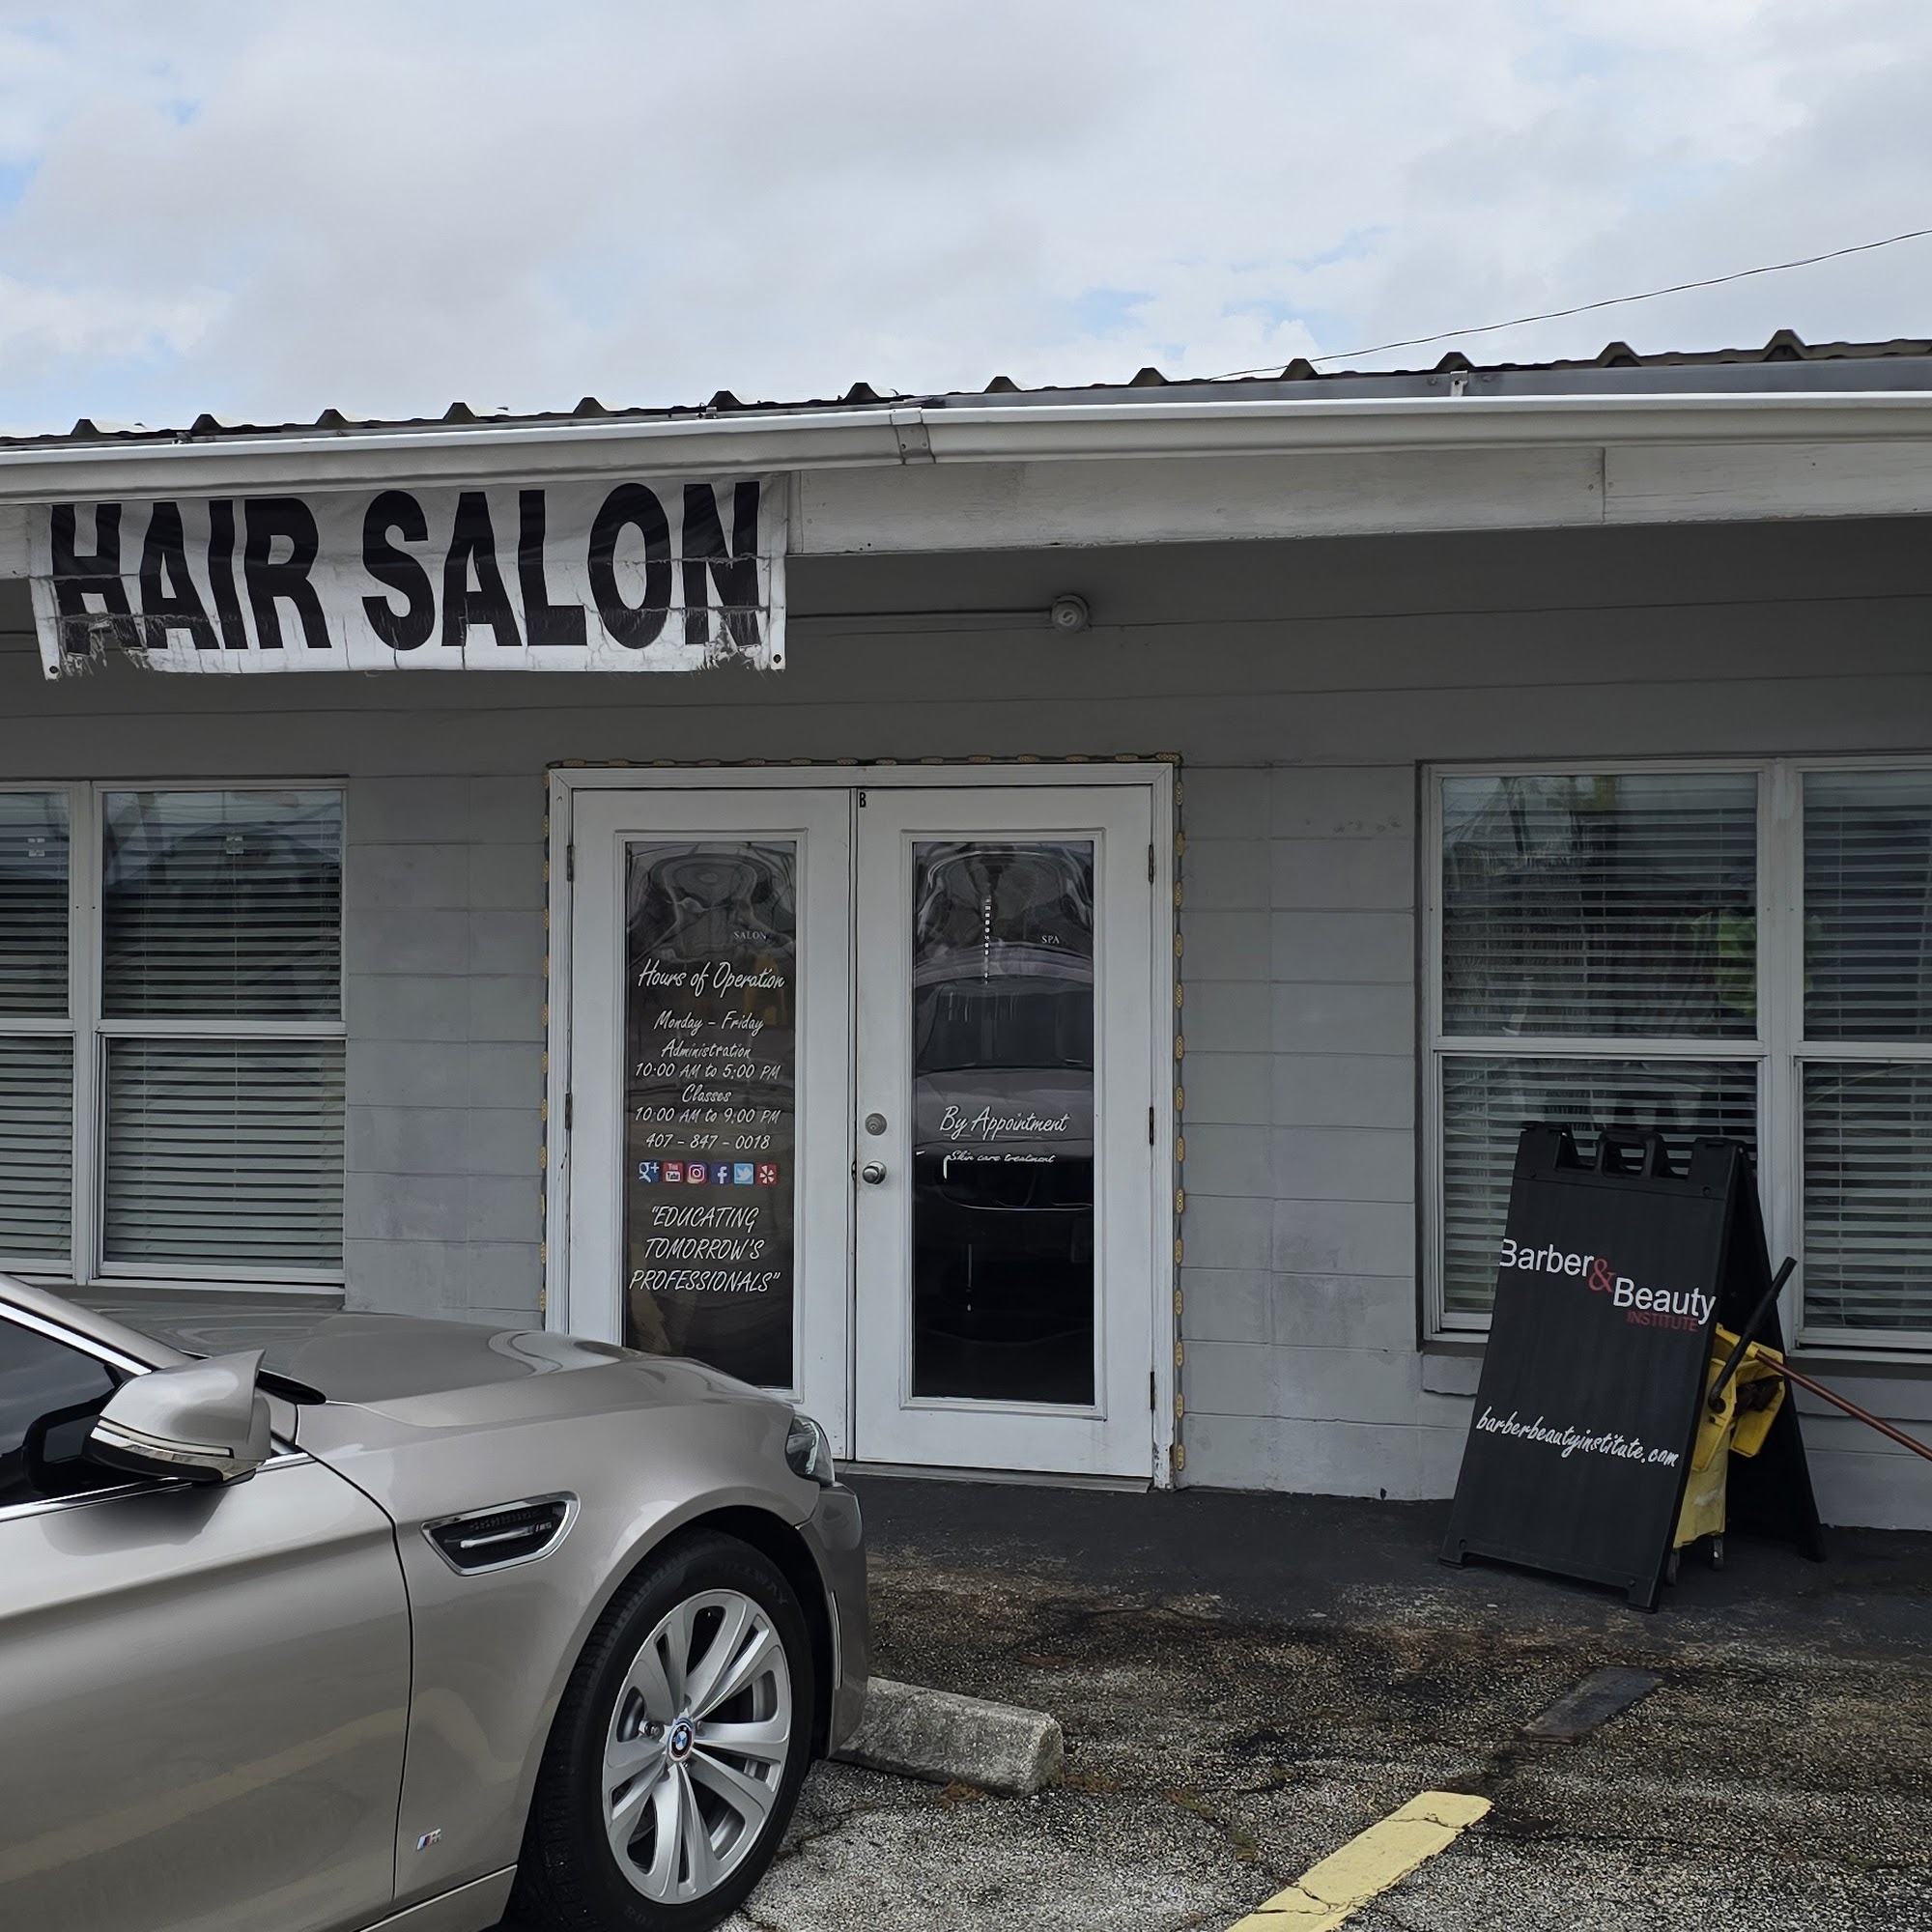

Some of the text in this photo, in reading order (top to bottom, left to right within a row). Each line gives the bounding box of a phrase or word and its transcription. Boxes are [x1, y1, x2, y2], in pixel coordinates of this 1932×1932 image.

[50, 481, 761, 655] HAIR SALON
[733, 930, 767, 940] SALON
[1041, 935, 1061, 945] SPA
[638, 958, 785, 998] Hours of Operation
[653, 1009, 703, 1036] Monday
[721, 1010, 764, 1037] Friday
[661, 1038, 751, 1058] Administration
[635, 1063, 781, 1080] 10:00 AM to 5:00 PM
[681, 1083, 732, 1102] Classes
[635, 1107, 781, 1124] 10:00 AM to 9:00 PM
[939, 1105, 1071, 1141] By Appointment
[645, 1133, 673, 1149] 407
[690, 1134, 719, 1150] 847
[735, 1135, 771, 1150] 0018
[950, 1150, 975, 1162] Skin
[1004, 1153, 1056, 1163] treatment
[644, 1237, 765, 1261] TOMORROW'S
[1499, 1238, 1594, 1277] Barber
[1612, 1277, 1717, 1324] Beauty
[1627, 1310, 1699, 1332] INSTITUTE
[1476, 1406, 1679, 1467] barberbeautyinstitute.com
